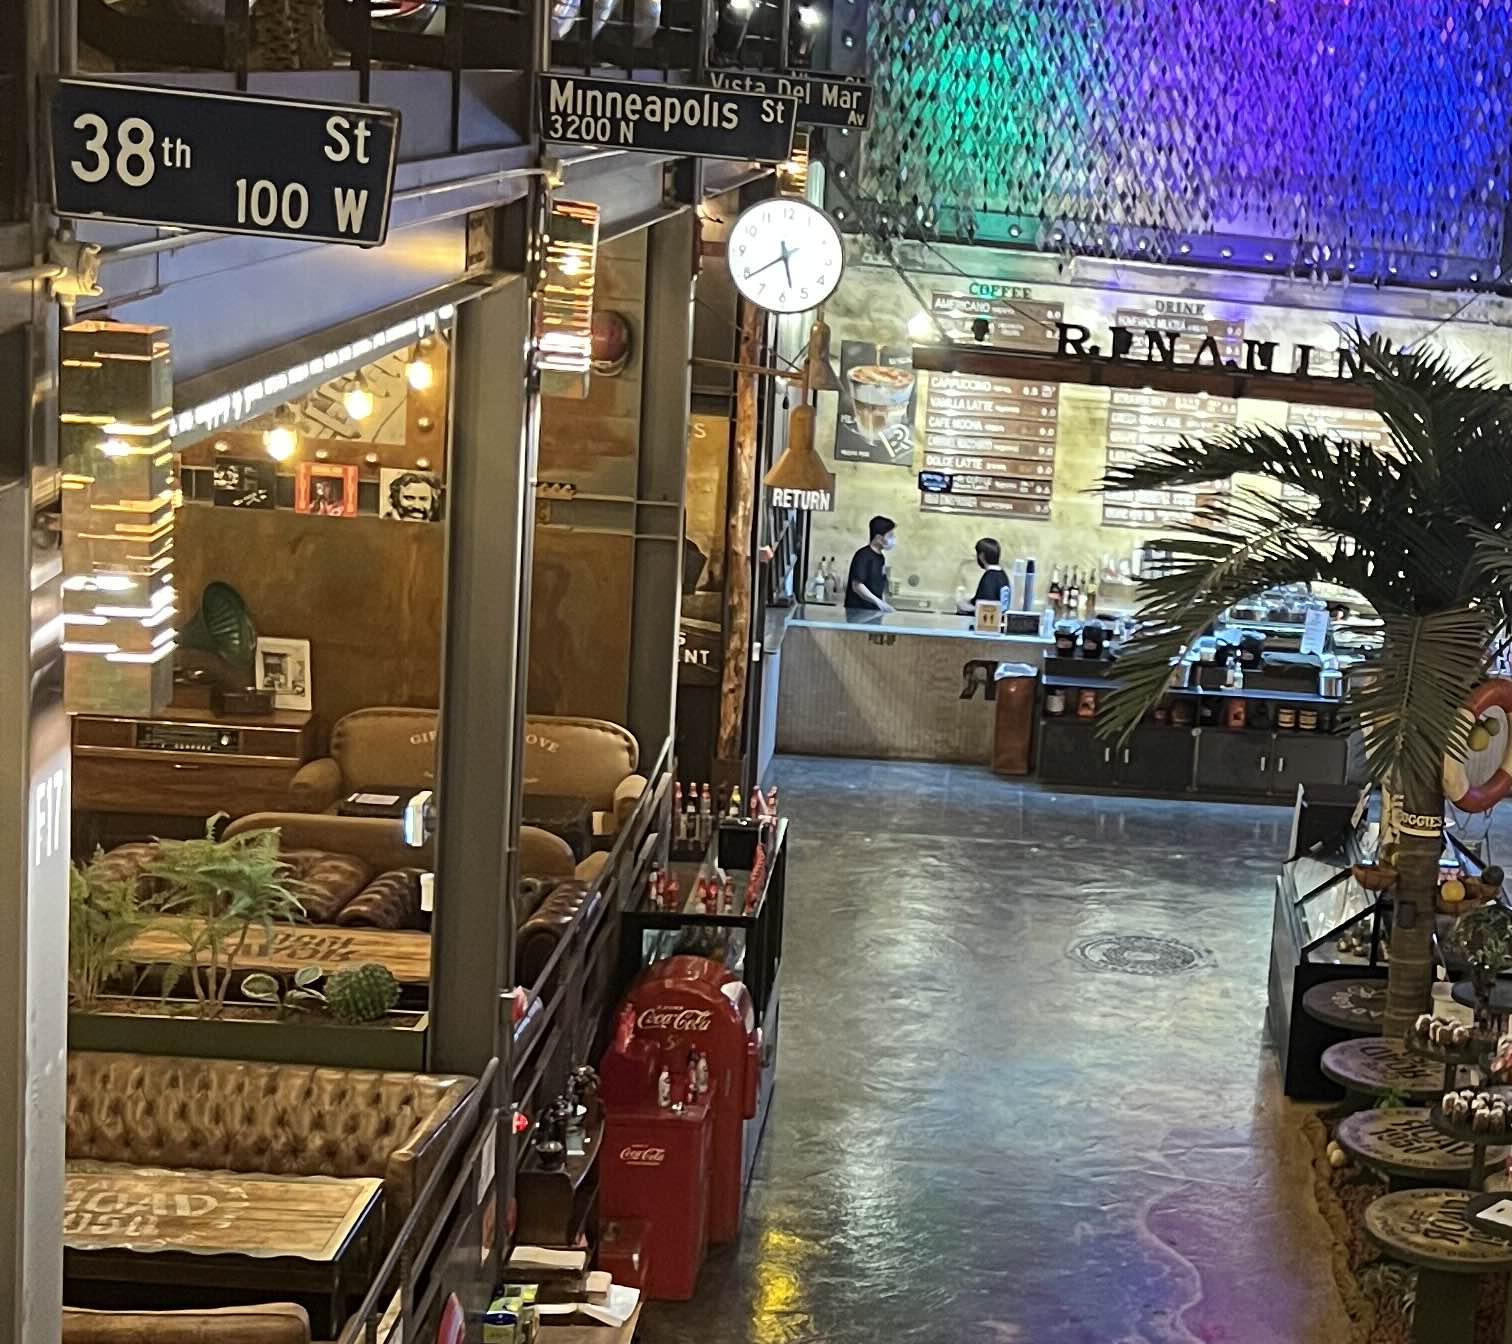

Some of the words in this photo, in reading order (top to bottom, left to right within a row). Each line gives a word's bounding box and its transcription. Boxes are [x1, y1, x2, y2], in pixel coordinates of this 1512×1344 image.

[709, 70, 766, 94] Vista
[777, 78, 811, 105] Del
[821, 83, 863, 110] Mar
[550, 78, 739, 133] Minneapolis
[760, 99, 785, 125] St
[550, 113, 611, 143] 3200
[619, 120, 634, 144] N
[847, 109, 864, 127] Av
[70, 112, 191, 188] 38th
[324, 114, 371, 164] St
[236, 177, 309, 230] 100
[334, 186, 369, 234] W
[783, 207, 796, 221] 12
[800, 287, 809, 300] 5
[968, 282, 1033, 300] COFFEE
[1155, 299, 1206, 316] DRINK
[772, 487, 831, 511] RETURN
